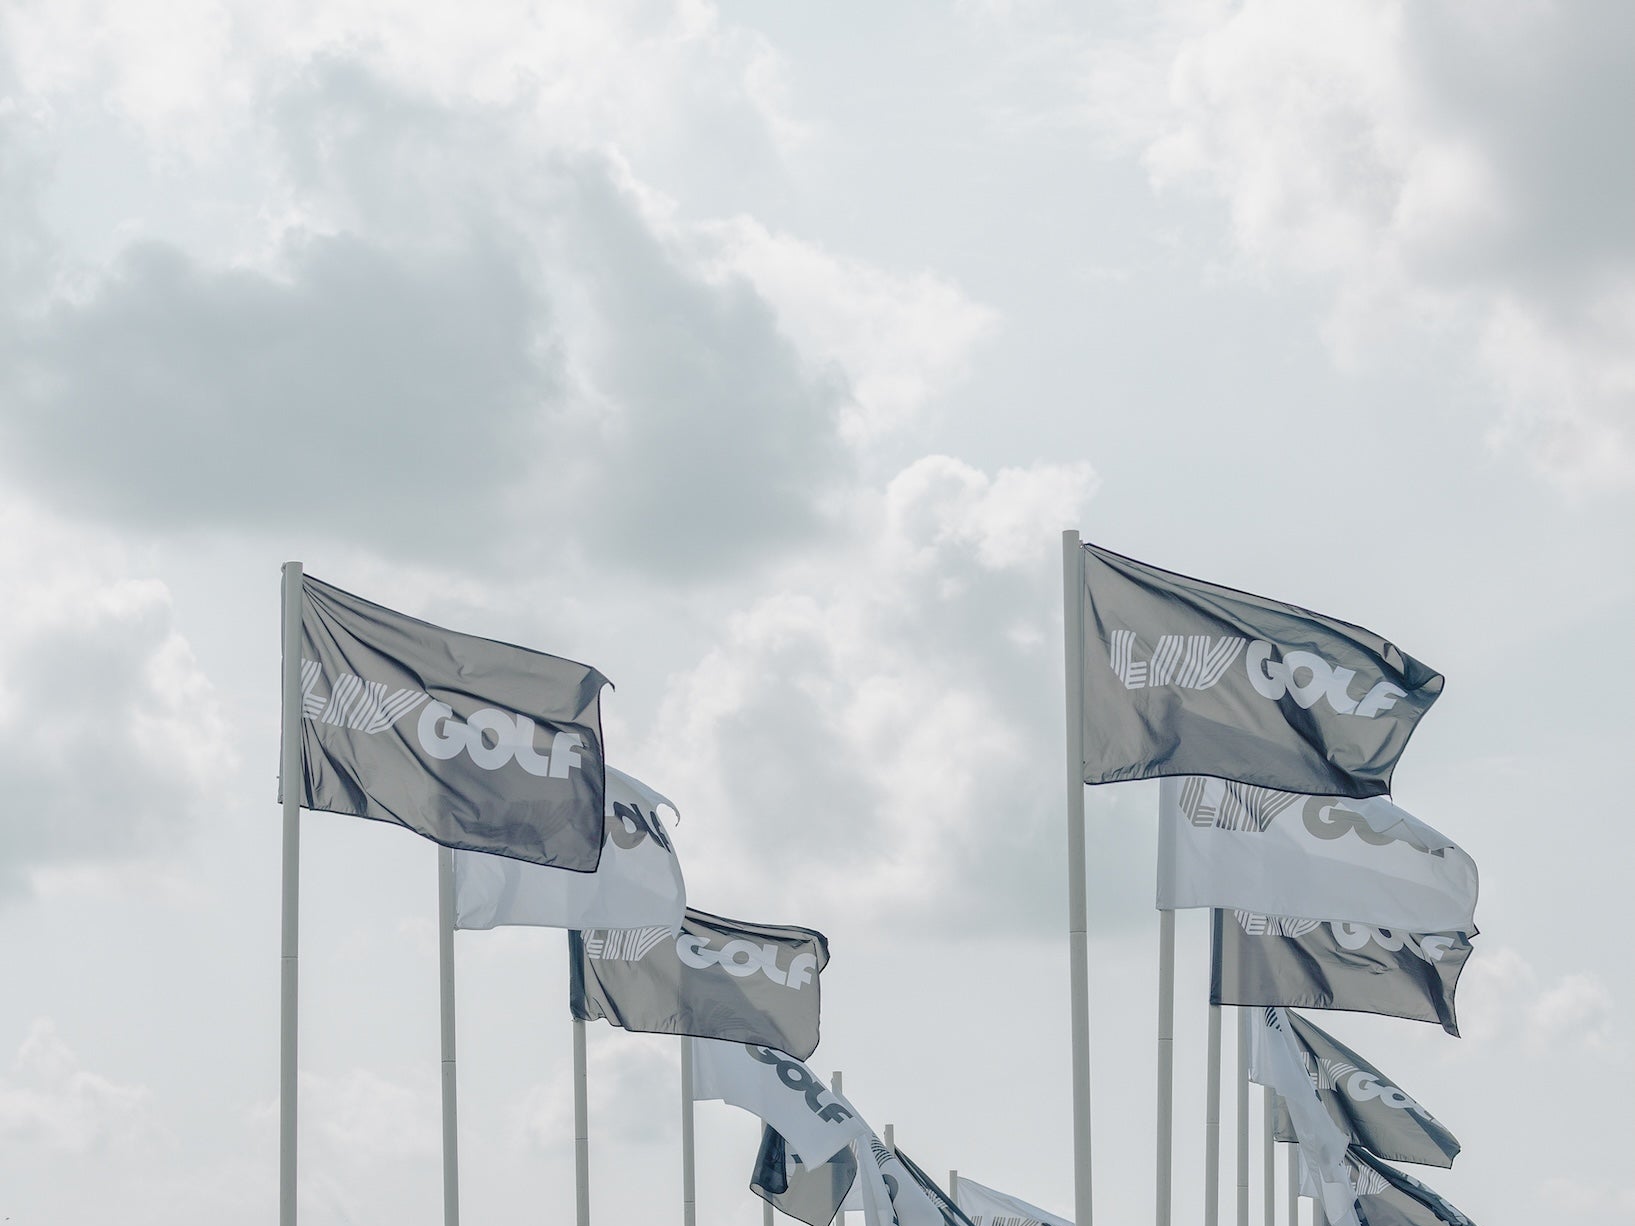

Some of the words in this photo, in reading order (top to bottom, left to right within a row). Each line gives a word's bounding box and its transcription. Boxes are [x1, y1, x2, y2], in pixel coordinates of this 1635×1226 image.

[1110, 630, 1247, 690] LIV
[1246, 639, 1408, 718] GOLF
[301, 658, 430, 735] LIV
[417, 699, 583, 779] GOLF
[602, 801, 672, 854] OLF
[1179, 777, 1302, 833] LIV
[676, 934, 818, 991] GOLF
[745, 1043, 854, 1124] GOLF
